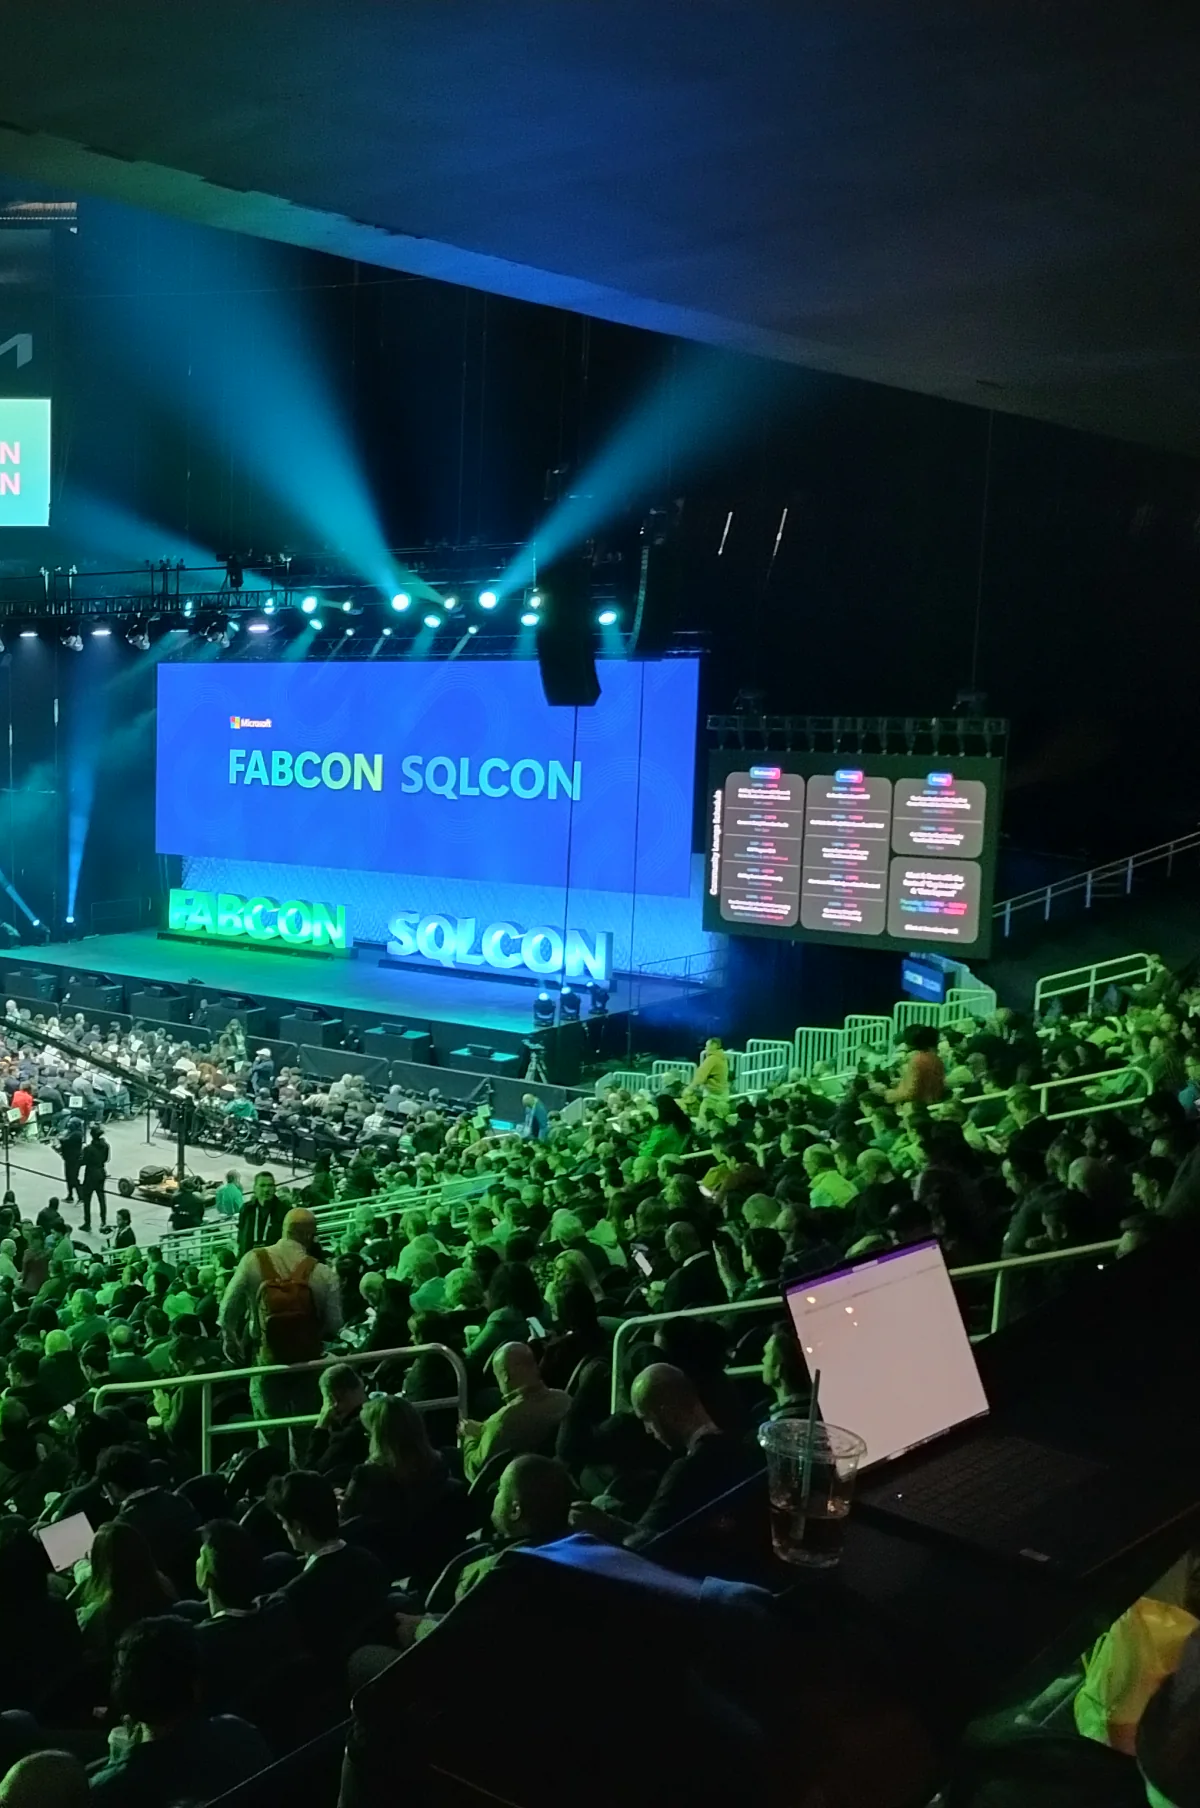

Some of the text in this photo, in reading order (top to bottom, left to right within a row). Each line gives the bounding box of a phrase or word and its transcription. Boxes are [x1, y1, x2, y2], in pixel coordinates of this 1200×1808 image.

[241, 718, 272, 728] Microsoft
[229, 748, 581, 801] FABCON SQLCON
[168, 888, 353, 950] FABCON
[387, 910, 613, 981] SQLCON
